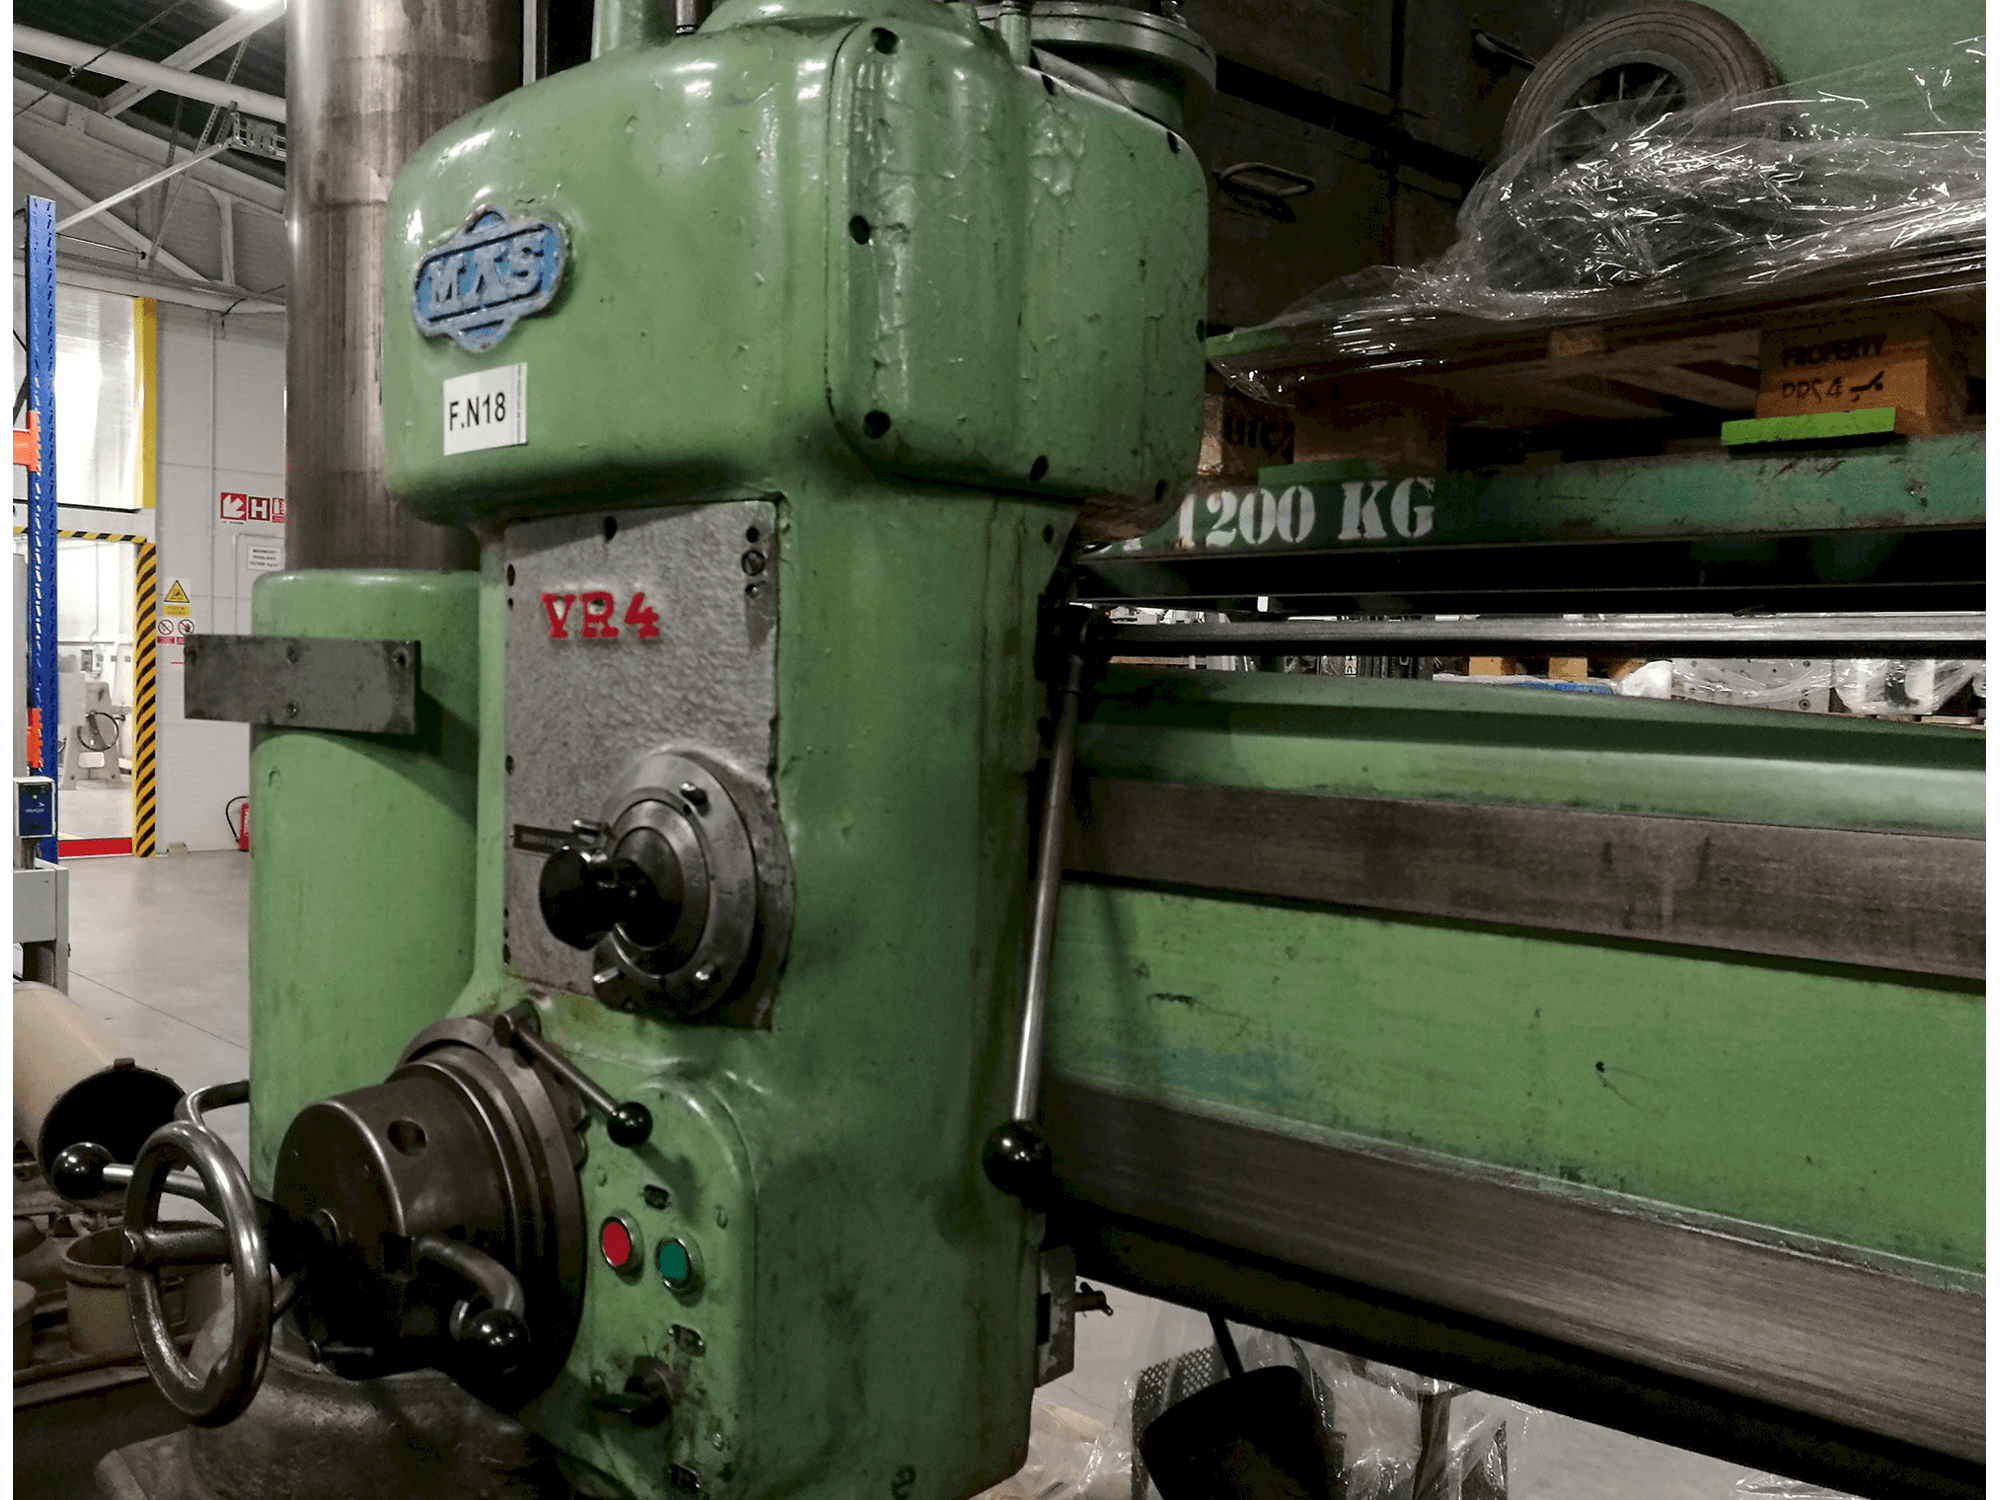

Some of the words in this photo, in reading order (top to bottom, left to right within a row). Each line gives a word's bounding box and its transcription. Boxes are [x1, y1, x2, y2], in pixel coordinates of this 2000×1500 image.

[449, 391, 506, 432] F.N18
[1175, 485, 1316, 547] 1200
[1338, 477, 1435, 540] KG
